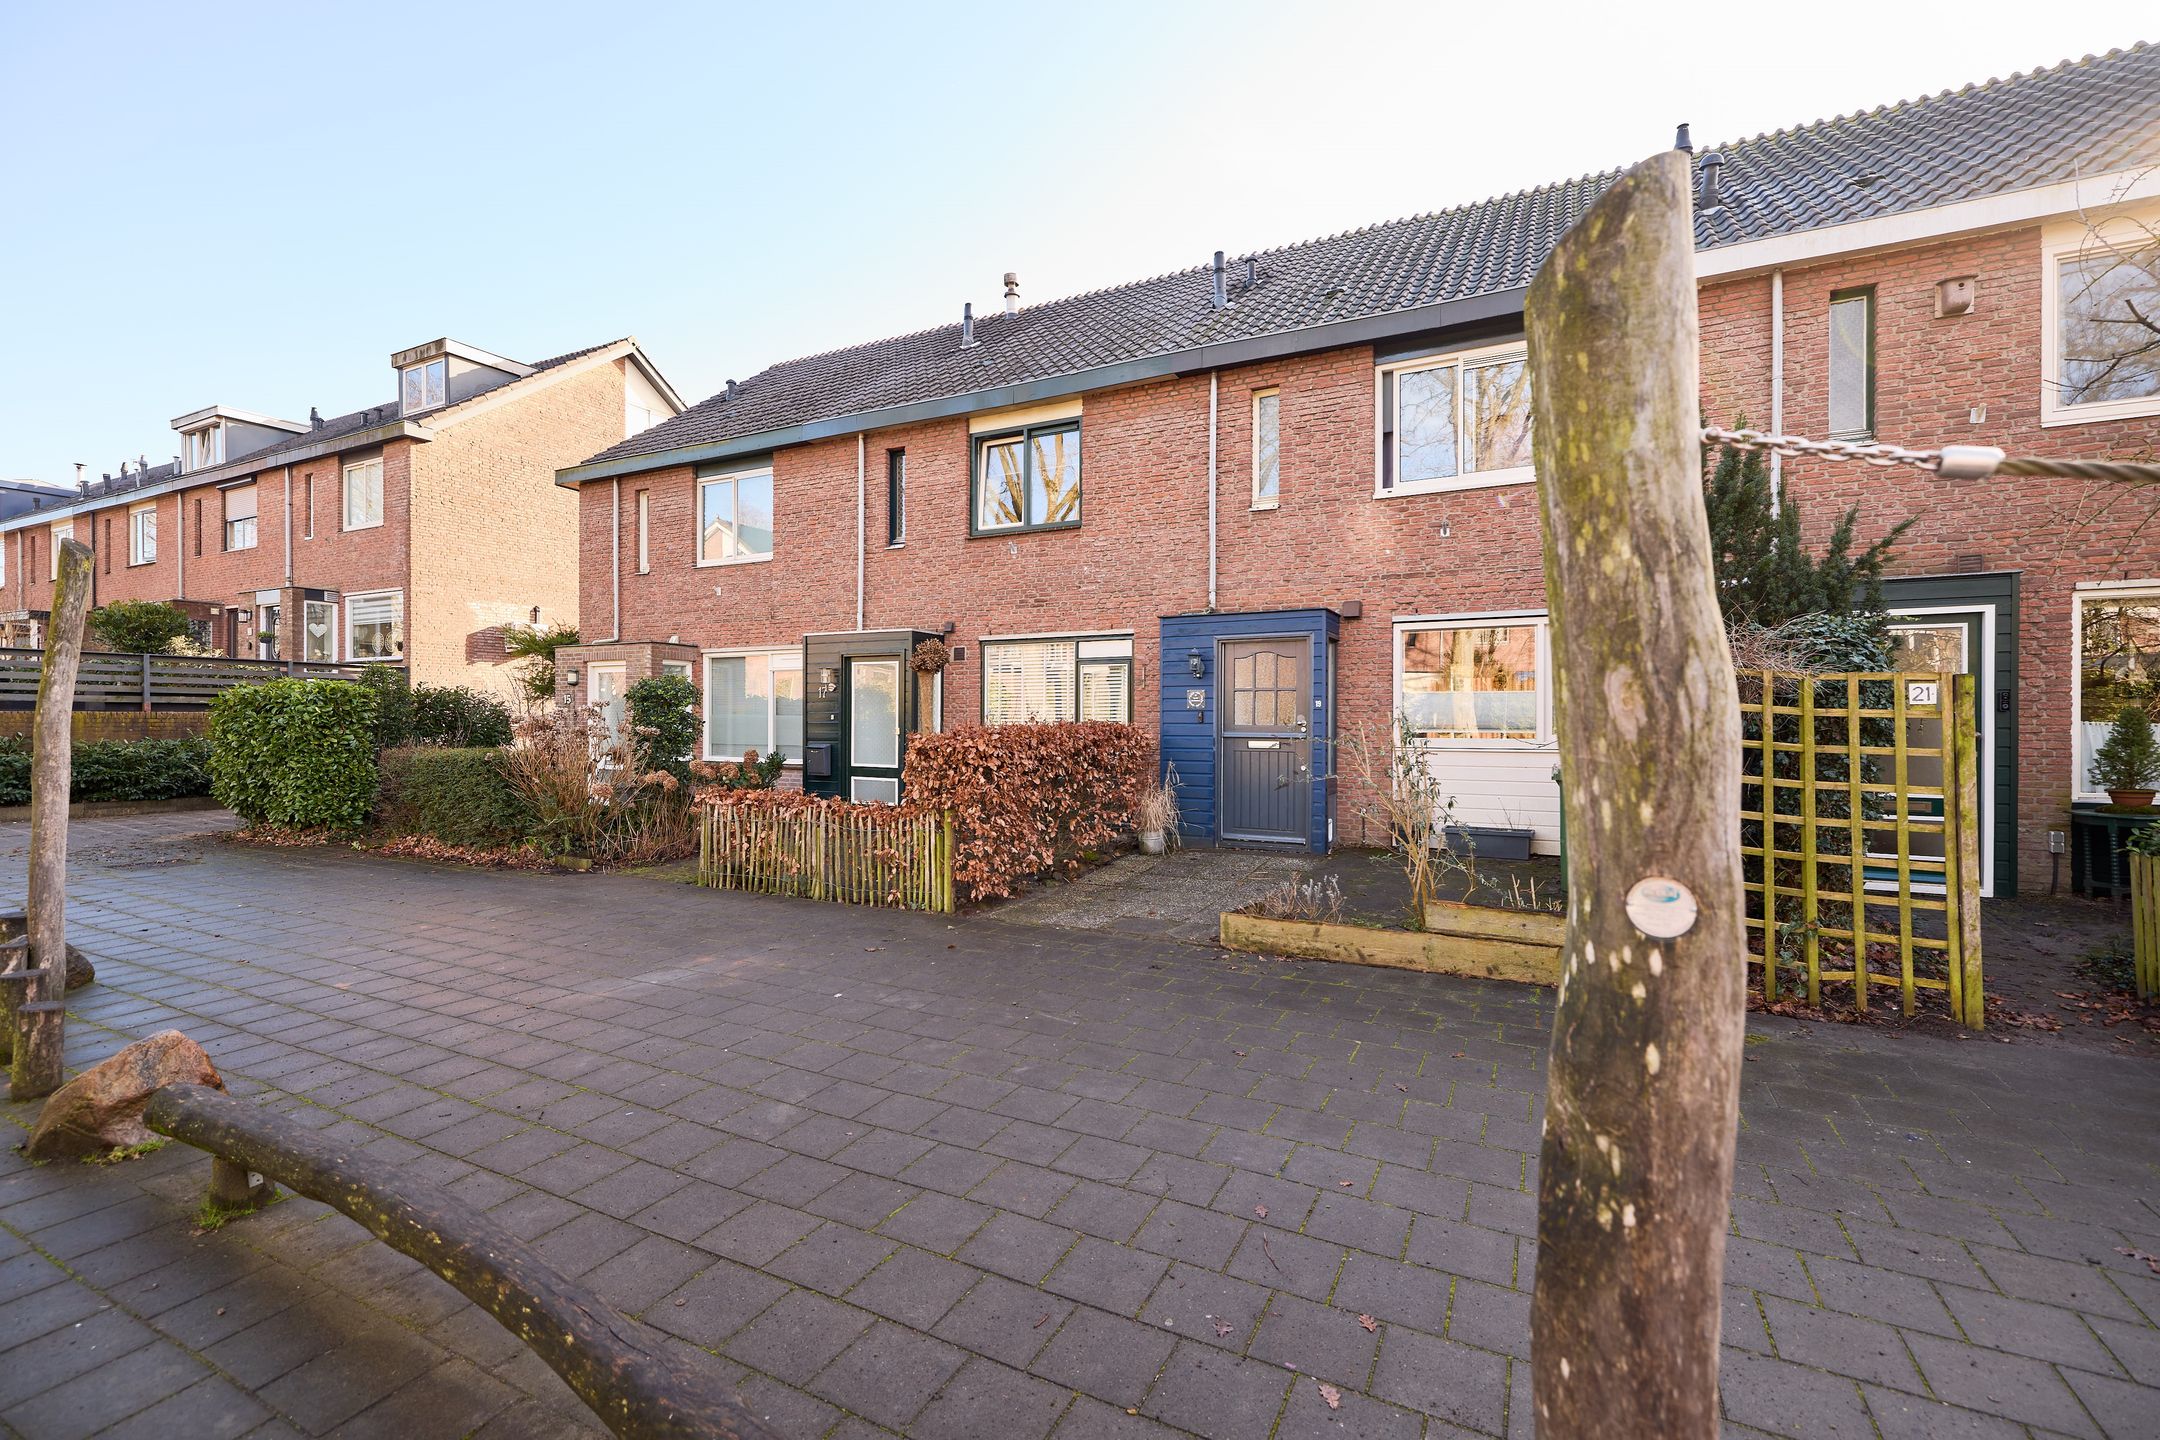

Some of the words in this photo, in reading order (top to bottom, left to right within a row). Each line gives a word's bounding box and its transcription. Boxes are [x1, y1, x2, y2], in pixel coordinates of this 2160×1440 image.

[818, 685, 828, 698] 17
[1912, 686, 1931, 702] 21
[563, 694, 572, 704] 15
